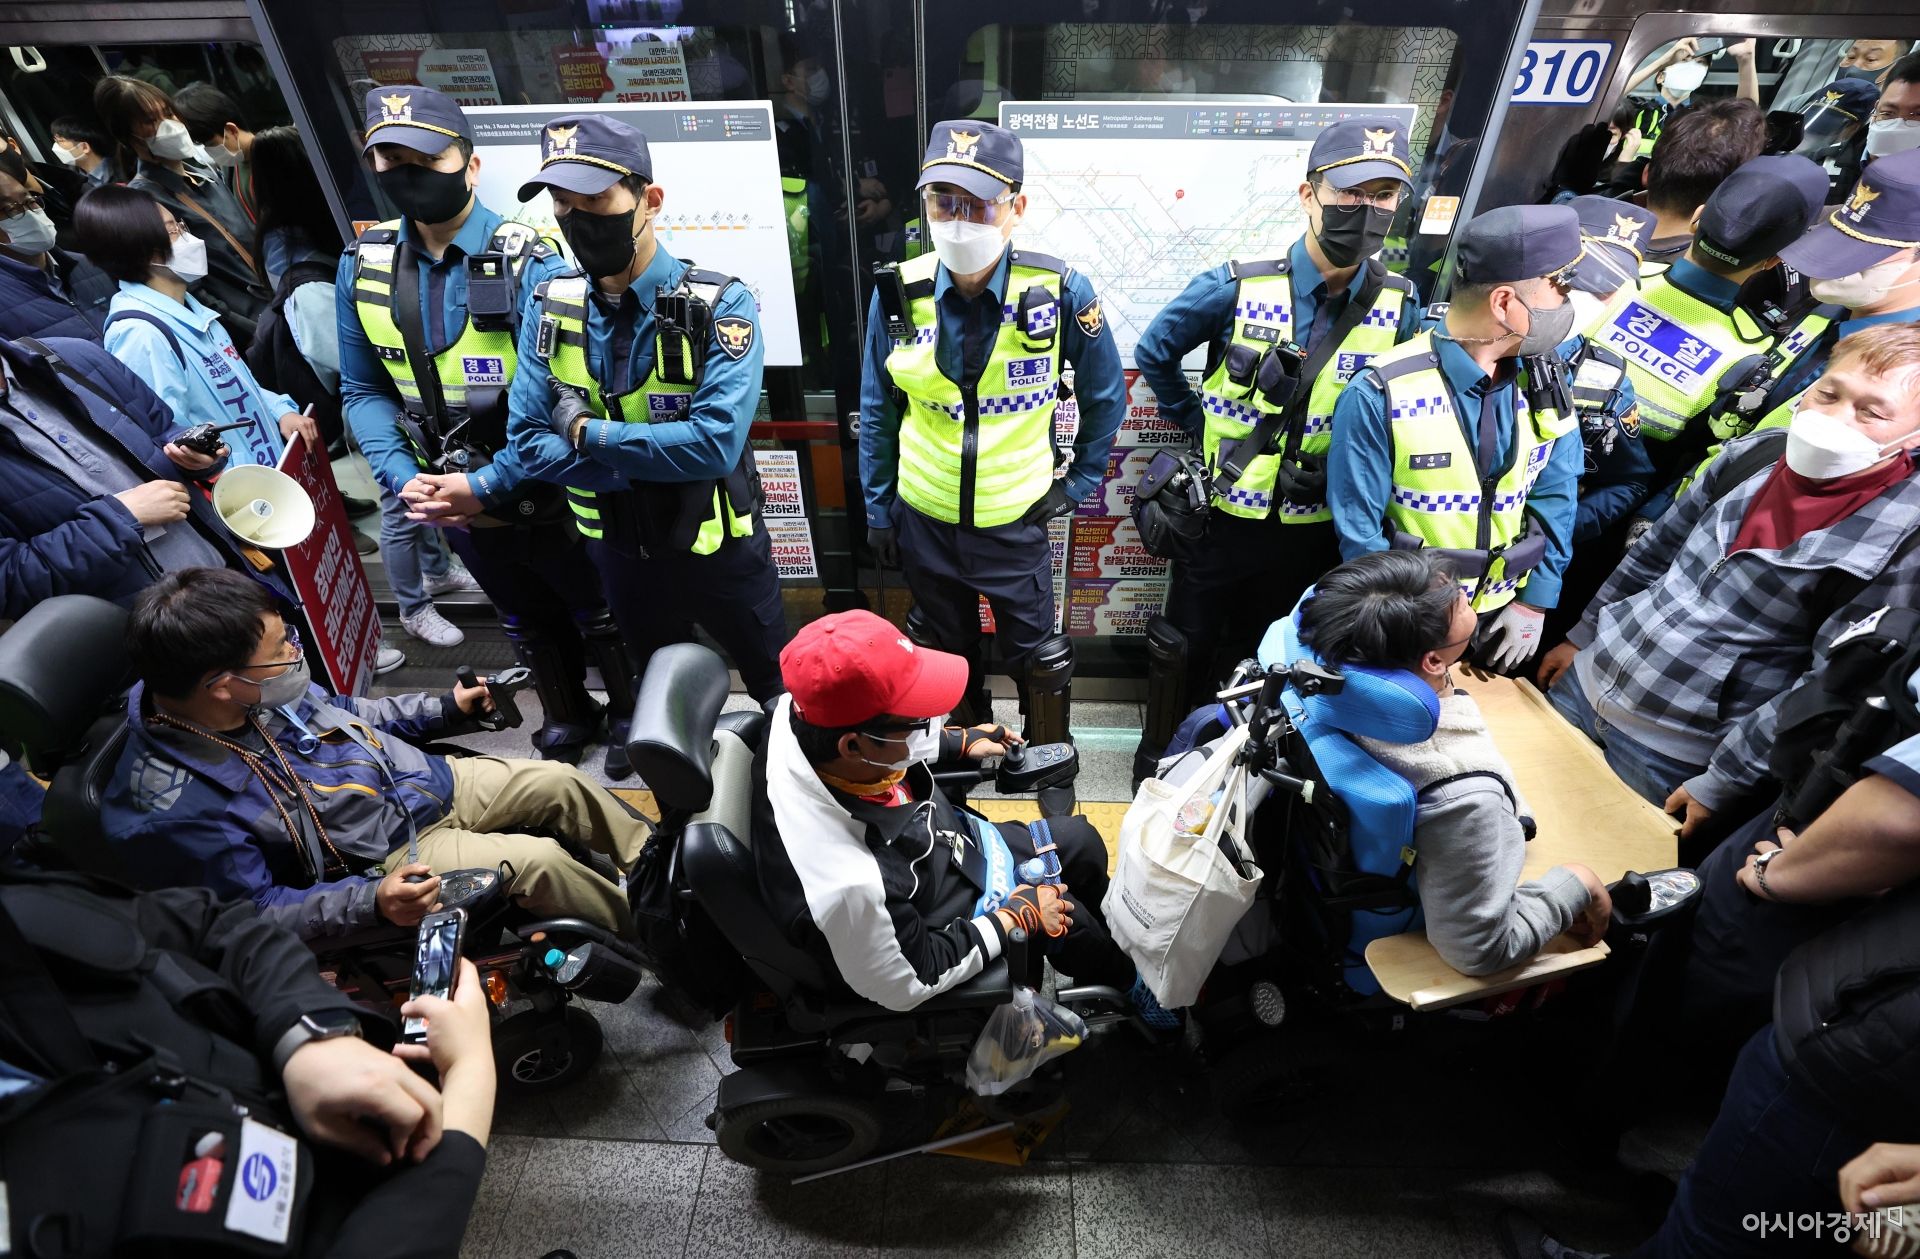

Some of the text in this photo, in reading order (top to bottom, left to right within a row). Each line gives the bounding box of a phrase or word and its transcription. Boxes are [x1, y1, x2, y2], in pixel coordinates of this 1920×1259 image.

[1009, 113, 1100, 130] 광역전철 노선도
[1627, 307, 1712, 369] 경찰
[1609, 331, 1690, 384] POLICE
[465, 359, 499, 374] 경찰
[1011, 359, 1048, 376] 경찰
[1011, 375, 1047, 386] POLICE
[1055, 402, 1076, 411] 시설
[762, 482, 797, 491] 24시간
[763, 504, 800, 514] 장하라!
[1114, 546, 1146, 555] 하루24
[314, 524, 342, 604] 장애인
[1104, 556, 1168, 565] 활동지원예산
[778, 566, 813, 575] 장하라!
[1120, 567, 1166, 576] 보장하라!
[324, 549, 357, 650] 권리예산
[1111, 619, 1148, 627] 6224억으
[336, 578, 368, 686] 보장하라!
